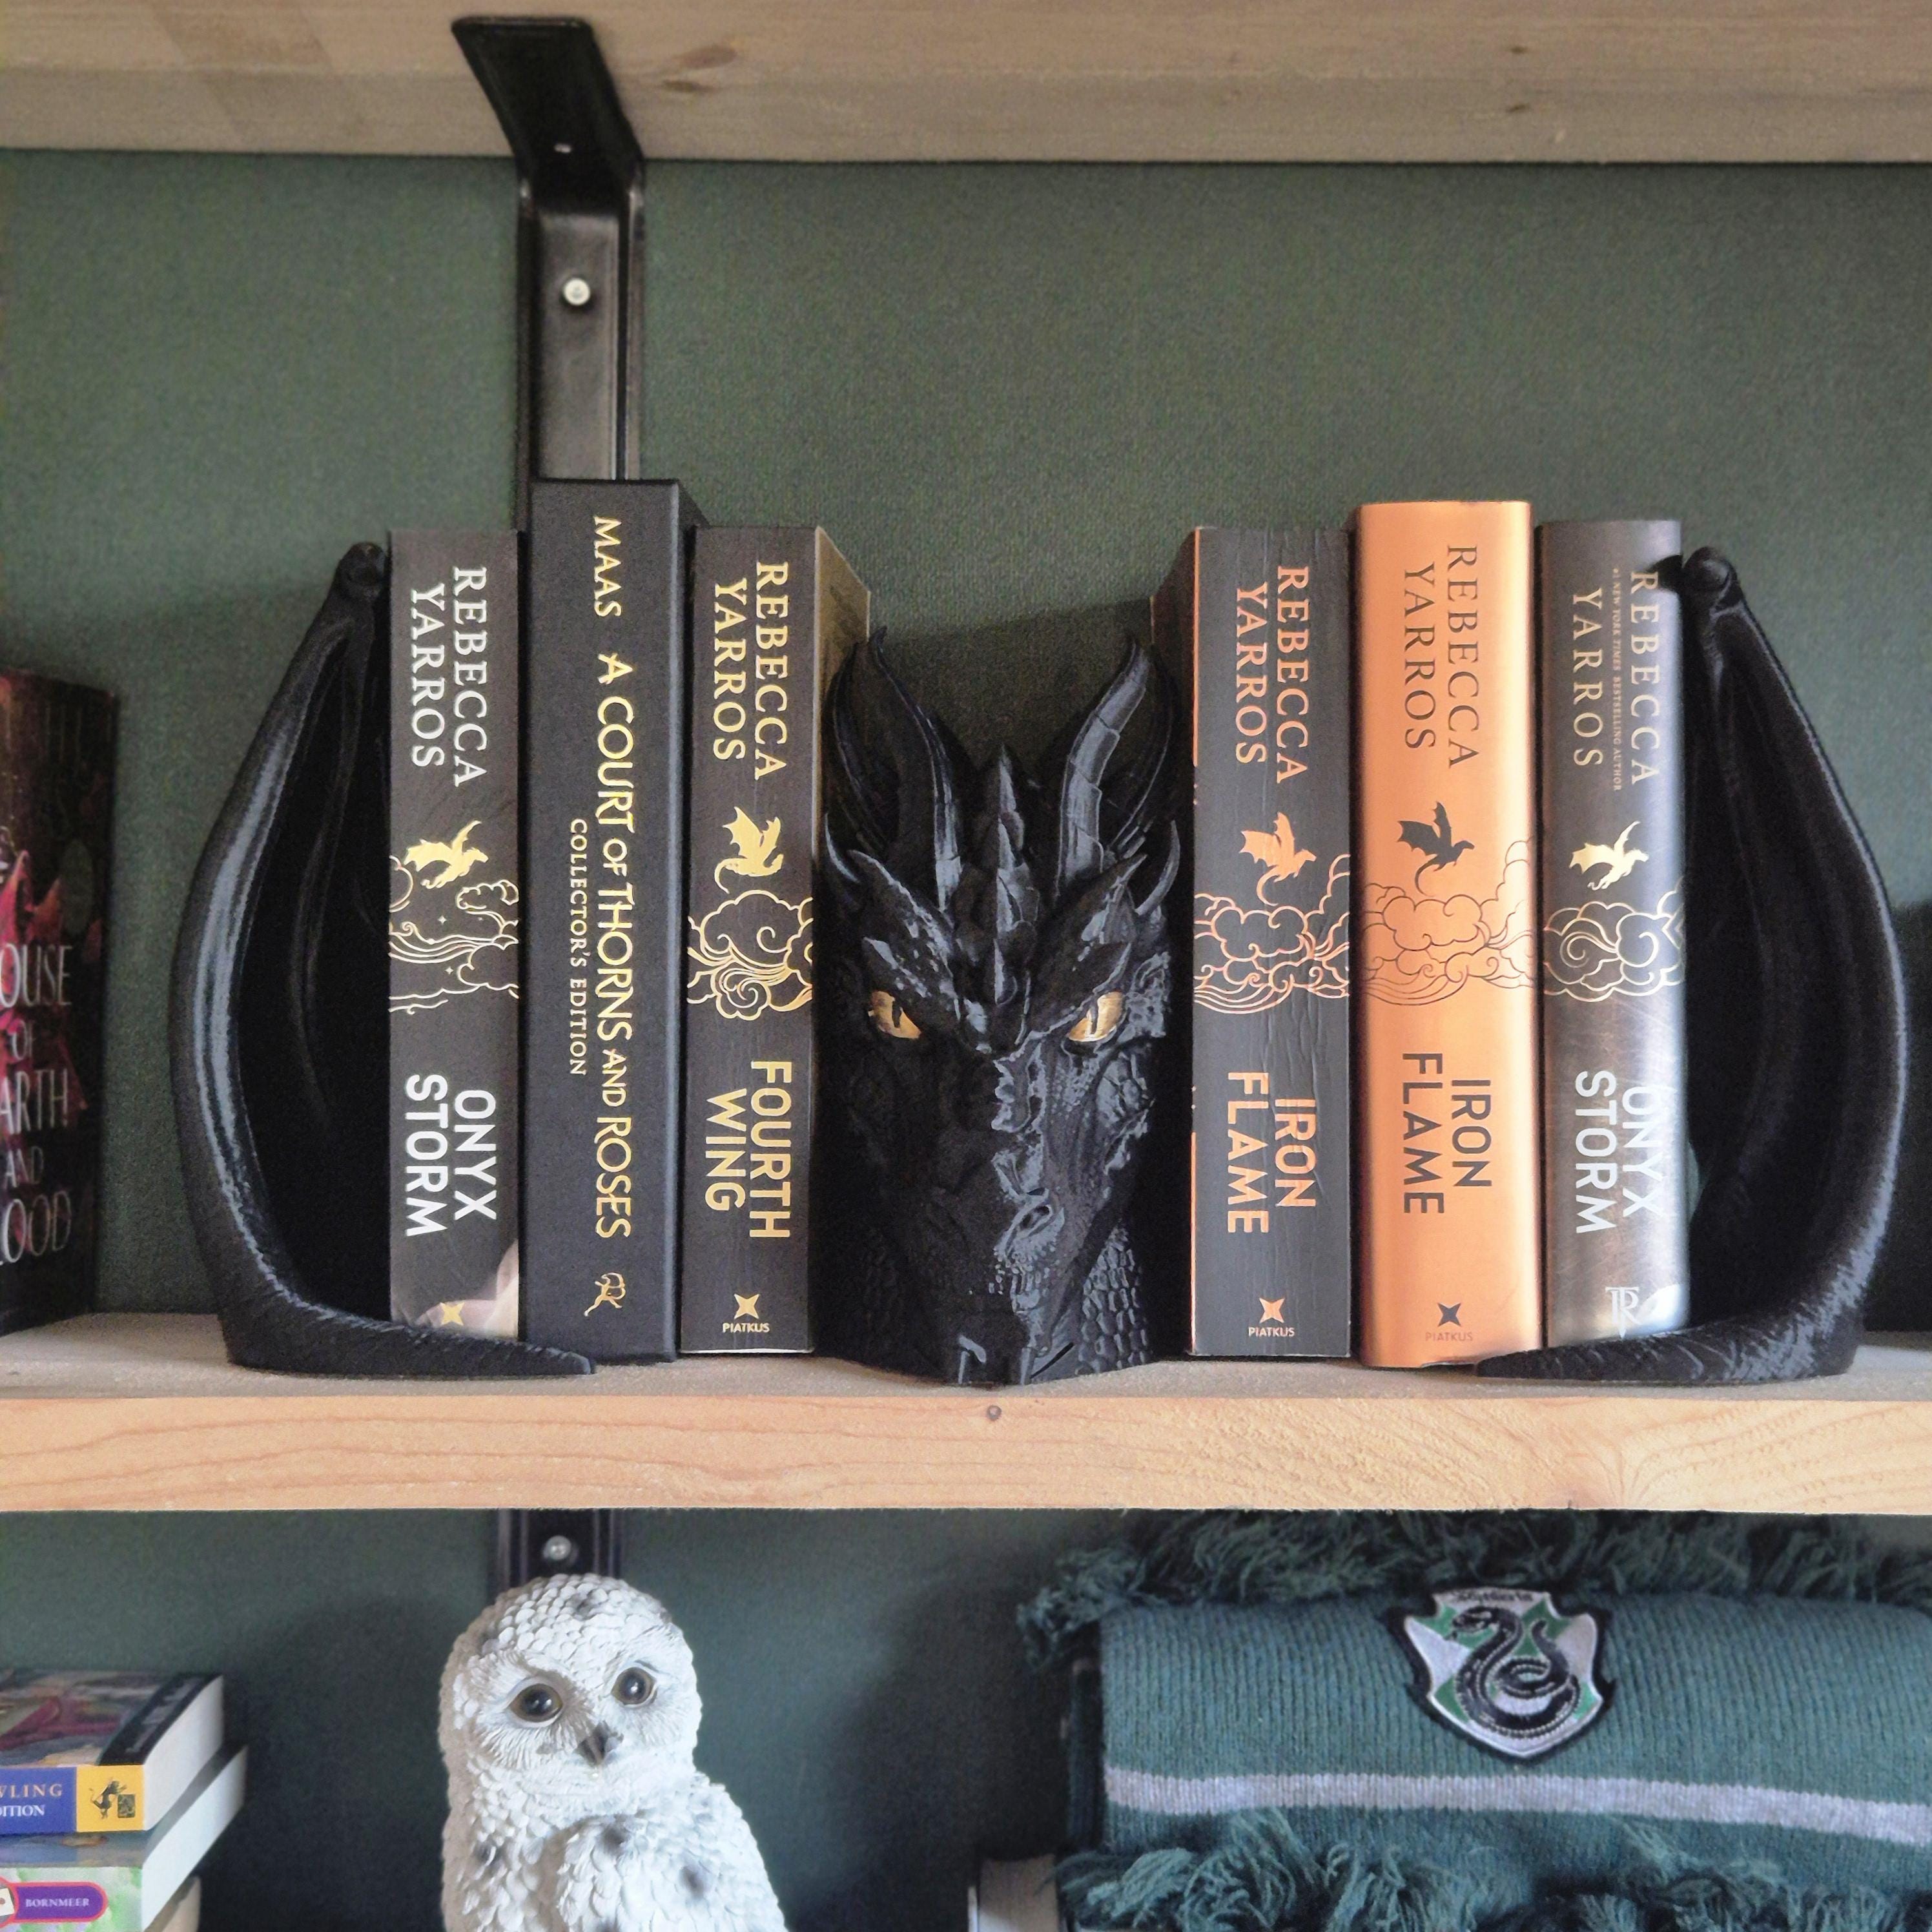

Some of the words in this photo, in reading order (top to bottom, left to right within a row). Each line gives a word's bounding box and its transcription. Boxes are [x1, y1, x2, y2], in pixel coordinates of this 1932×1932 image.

[593, 515, 622, 617] MAAS
[411, 584, 445, 766] YARROS
[453, 566, 488, 787] REBECCA
[597, 653, 633, 684] A
[713, 578, 747, 761] YARROS
[754, 561, 789, 780] REBECCA
[1235, 581, 1268, 764] YARROS
[1276, 566, 1310, 784] REBECCA
[1404, 562, 1436, 749] YARROS
[1447, 544, 1479, 768] REBECCA
[1573, 588, 1603, 766] YARROS
[1613, 639, 1621, 670] TIMES
[1613, 676, 1621, 744] BESTSELLING
[1630, 571, 1660, 785] REBECCA
[595, 695, 635, 834] COURT
[1613, 748, 1621, 790] AUTHOR
[570, 819, 591, 967] COLLECTOR'S
[602, 838, 628, 876] OF
[570, 978, 587, 1076] EDITION
[595, 882, 635, 1041] THORNS
[601, 1049, 626, 1107] AND
[1402, 1053, 1444, 1214] FLAME
[1452, 1079, 1492, 1187] IRON
[3, 1145, 44, 1188] AND
[405, 1074, 448, 1236] STORM
[454, 1089, 497, 1220] ONYX
[594, 1116, 632, 1238] ROSES
[705, 1088, 746, 1211] WING
[749, 1061, 792, 1237] FOURTH
[1227, 1071, 1269, 1234] FLAME
[1275, 1098, 1316, 1207] IRON
[1576, 1071, 1617, 1233] STORM
[1622, 1085, 1664, 1217] ONYX
[0, 1191, 71, 1266] OOD
[722, 1322, 770, 1333] PIATKUS
[1248, 1326, 1295, 1337] PIATKUS
[1425, 1331, 1474, 1342] PIATKUS
[25, 1898, 90, 1907] BORNMEER
